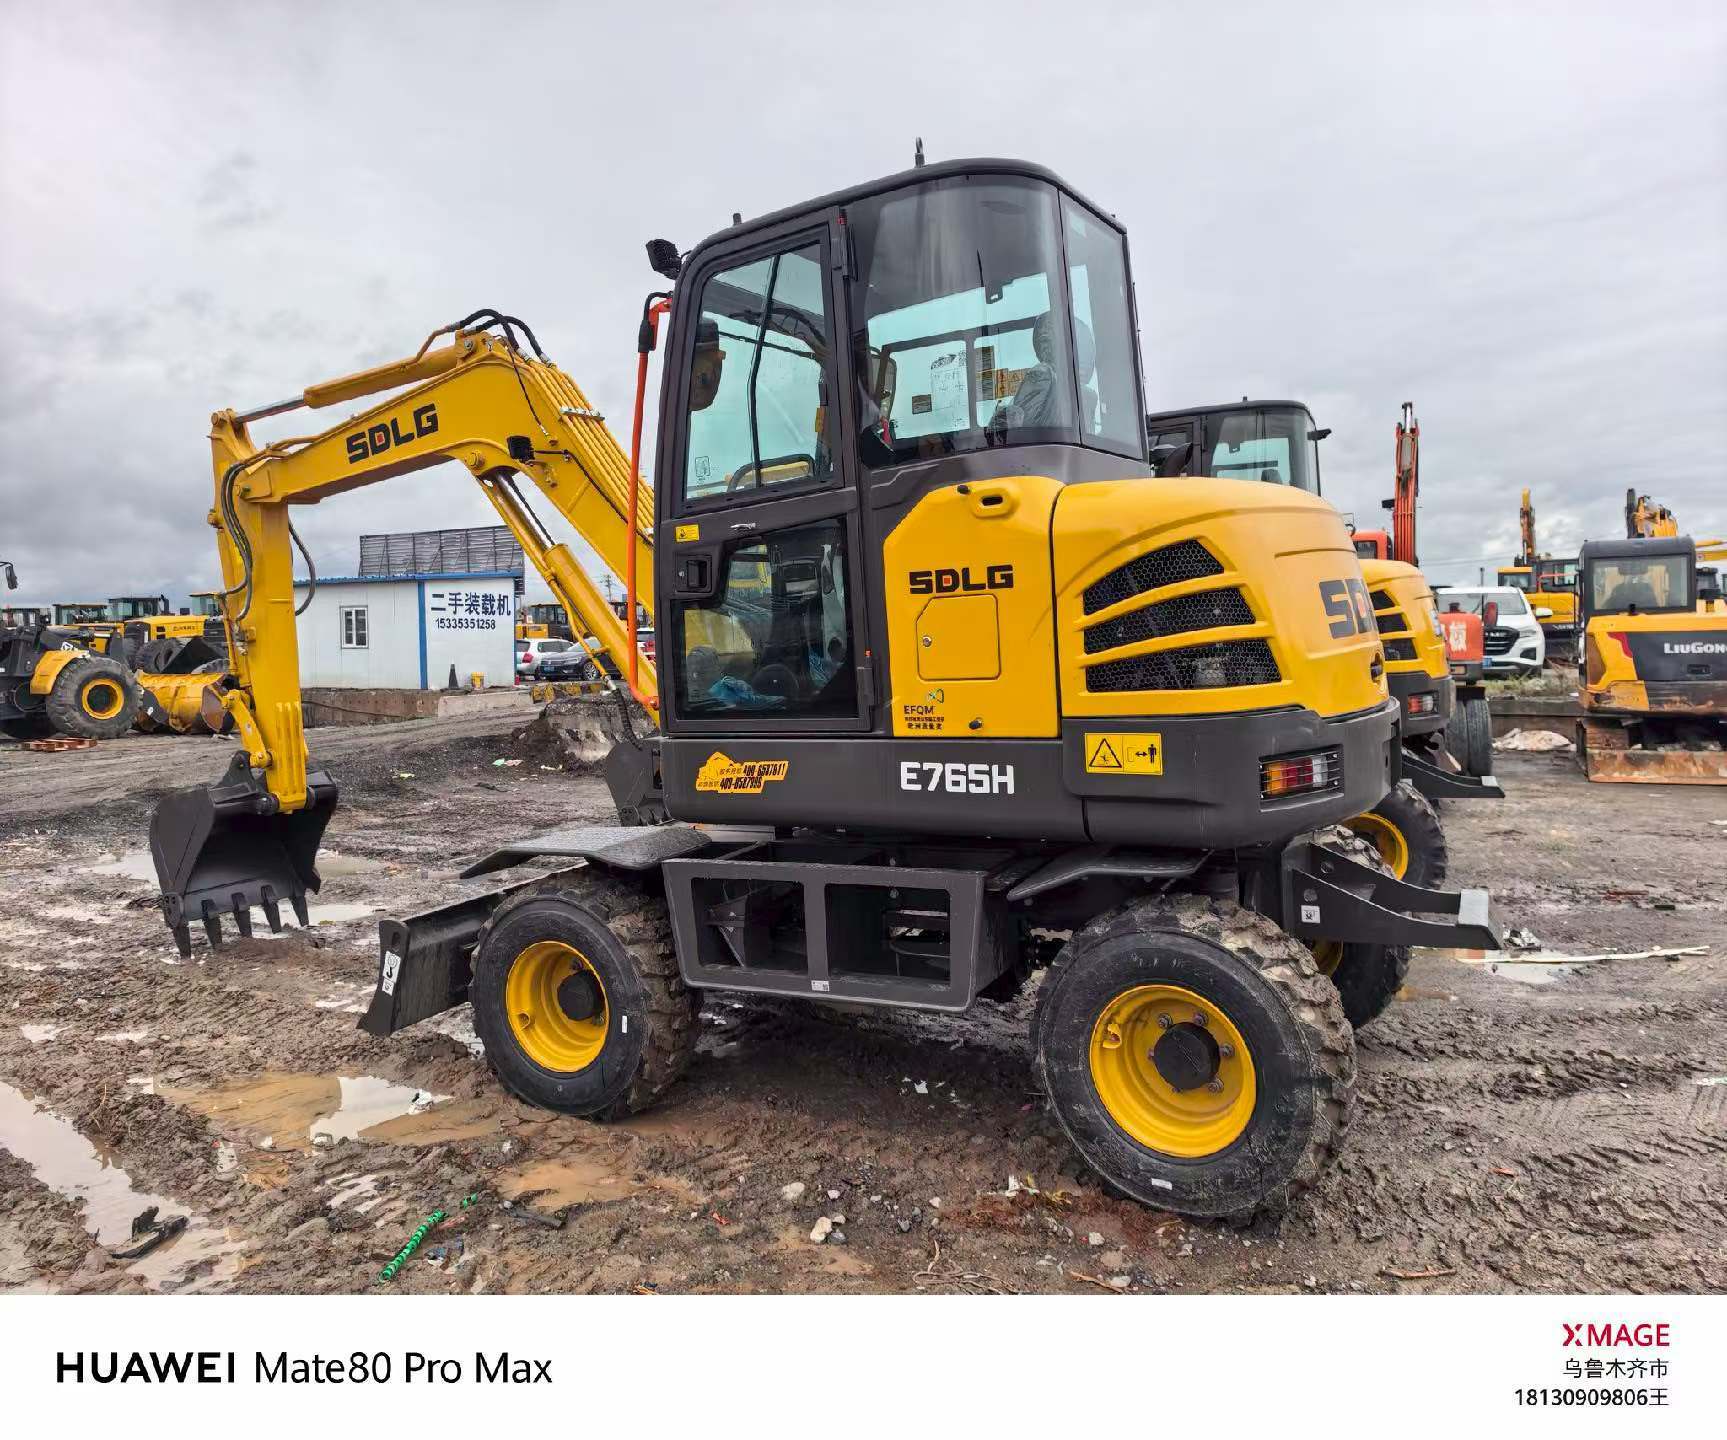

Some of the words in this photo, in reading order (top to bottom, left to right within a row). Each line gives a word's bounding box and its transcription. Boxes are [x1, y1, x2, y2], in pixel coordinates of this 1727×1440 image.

[346, 403, 438, 464] SDLG
[909, 564, 1014, 594] SDLG
[431, 592, 511, 616] 二手装载机
[1319, 578, 1376, 639] SD
[435, 617, 496, 630] 15335351258
[1664, 642, 1727, 654] LIUGON
[903, 705, 935, 716] EFQM
[900, 761, 1015, 795] E765H
